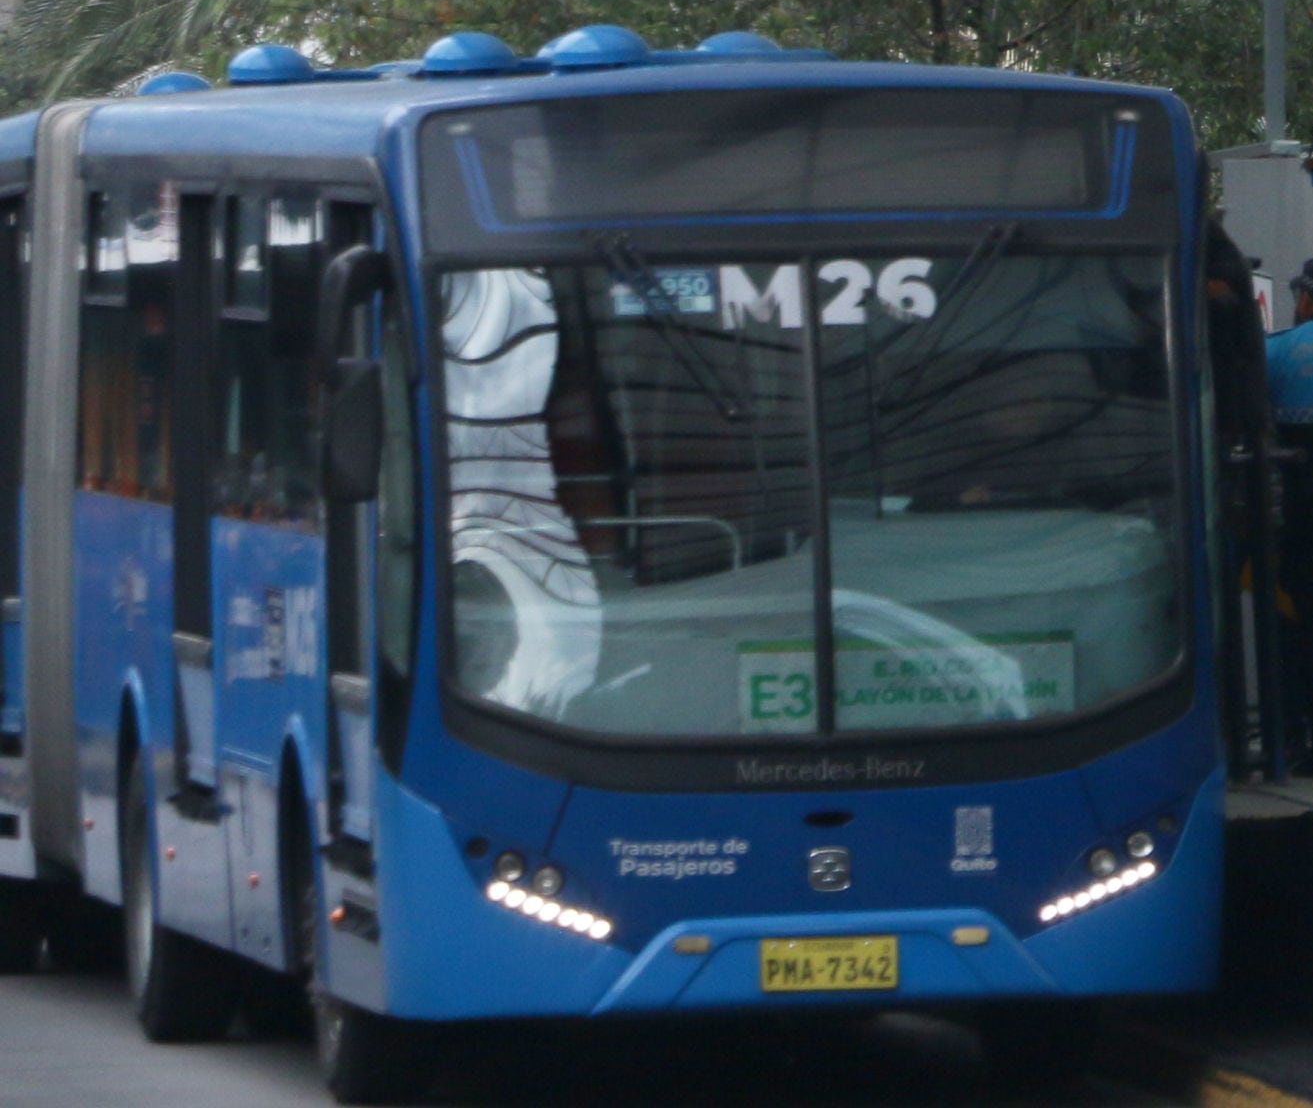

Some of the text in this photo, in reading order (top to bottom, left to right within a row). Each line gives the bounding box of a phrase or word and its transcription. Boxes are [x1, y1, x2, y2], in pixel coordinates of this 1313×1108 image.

[750, 672, 813, 721] E3
[836, 680, 915, 706] LAYÓN
[735, 755, 927, 783] Mercedes-Benz
[608, 837, 749, 864] Transporte de
[619, 857, 737, 880] Pasajeros
[950, 858, 998, 872] Quito
[765, 956, 891, 985] PMA-7342
